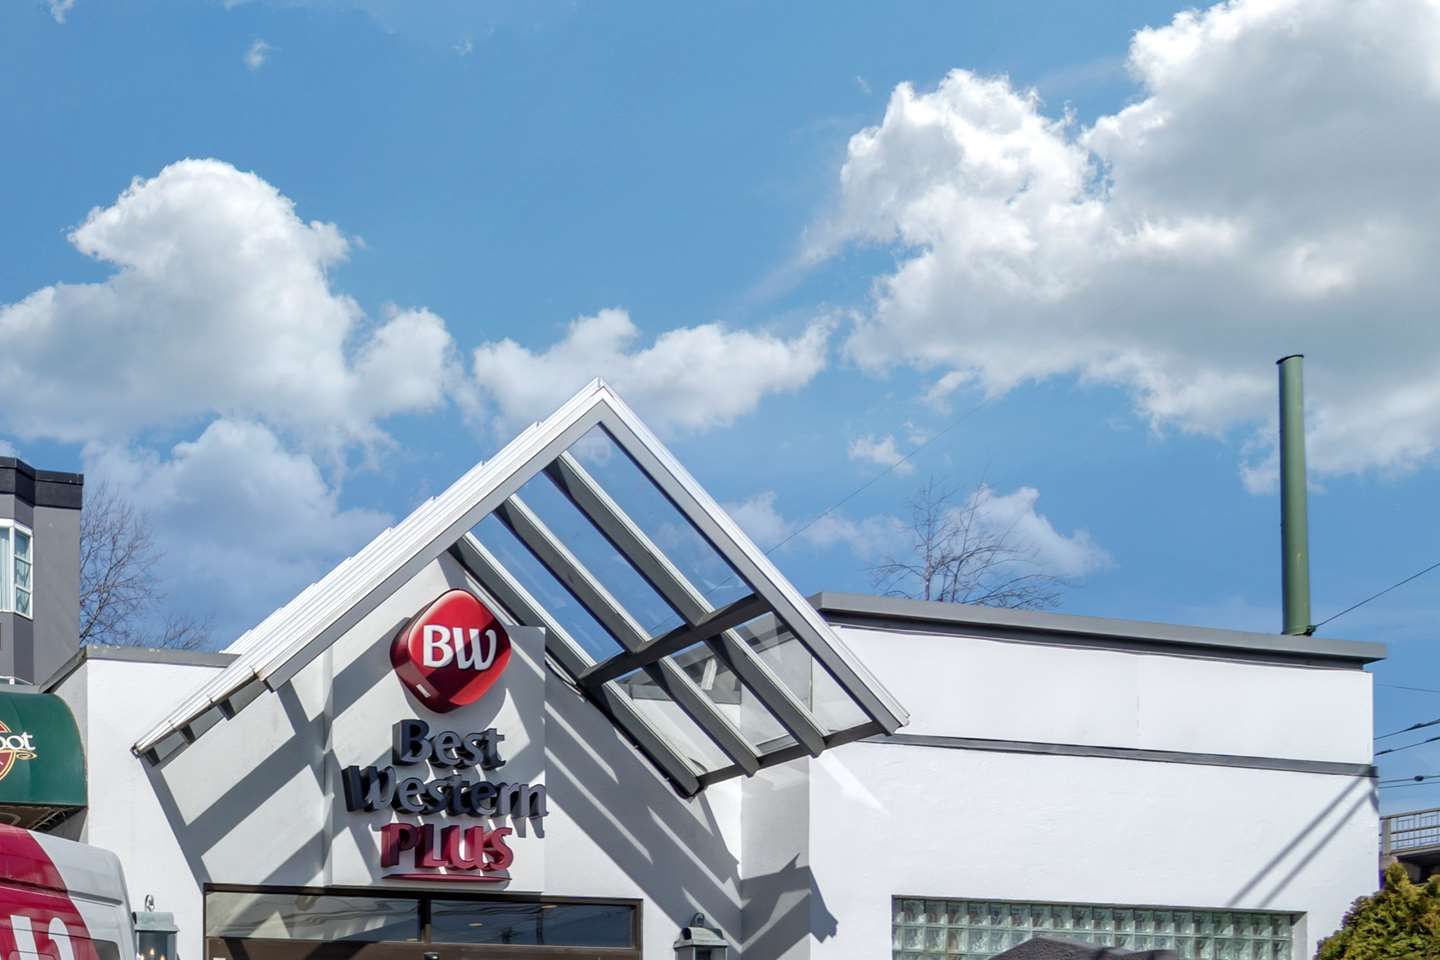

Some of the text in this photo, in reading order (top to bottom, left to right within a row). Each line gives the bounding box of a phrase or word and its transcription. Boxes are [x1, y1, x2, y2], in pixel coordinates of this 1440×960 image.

[422, 624, 497, 671] BW
[392, 719, 506, 771] Best
[341, 765, 550, 818] Western
[381, 823, 514, 872] PLUS
